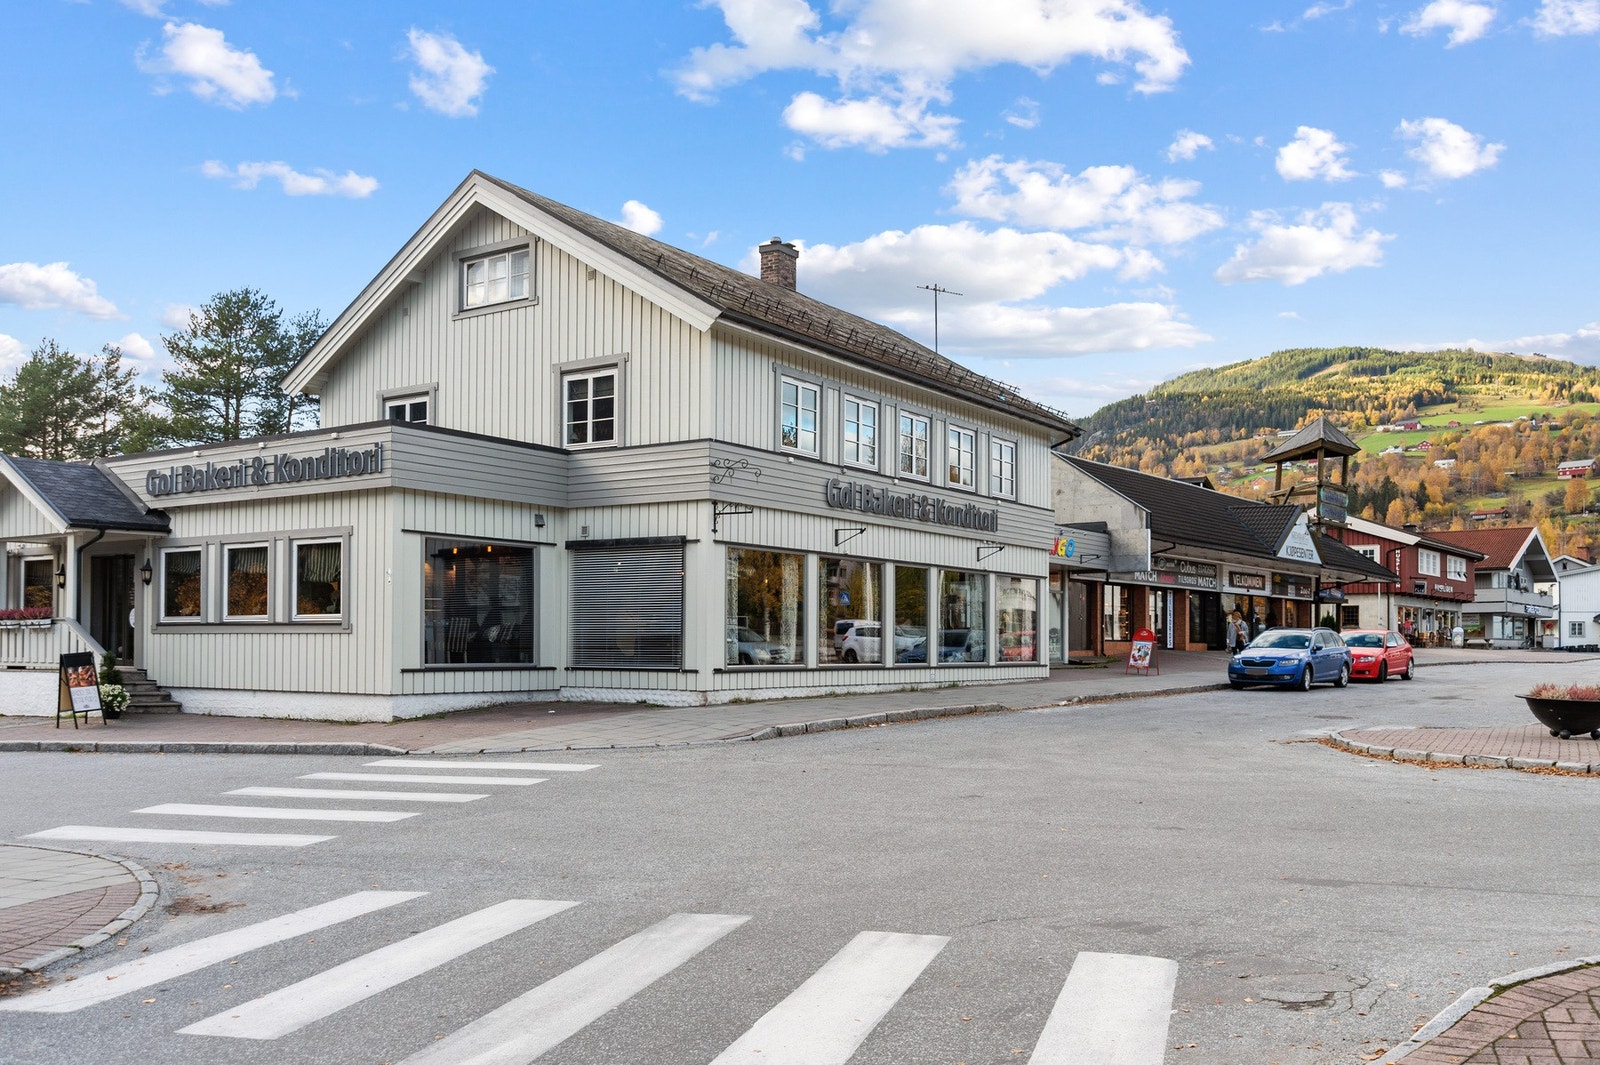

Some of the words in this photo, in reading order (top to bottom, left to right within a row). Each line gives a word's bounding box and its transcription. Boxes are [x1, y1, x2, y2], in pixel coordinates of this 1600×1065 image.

[145, 466, 177, 497] Gol
[181, 458, 247, 493] Bakeri
[250, 455, 268, 486] &
[273, 442, 383, 484] Konditori
[826, 477, 857, 511] Gol
[861, 483, 915, 519] Bakeri
[918, 494, 932, 522] &
[934, 497, 999, 532] Konditori
[1134, 571, 1158, 583] MATCH
[1198, 577, 1217, 588] MATCH
[1232, 574, 1263, 588] VELKOMMEN
